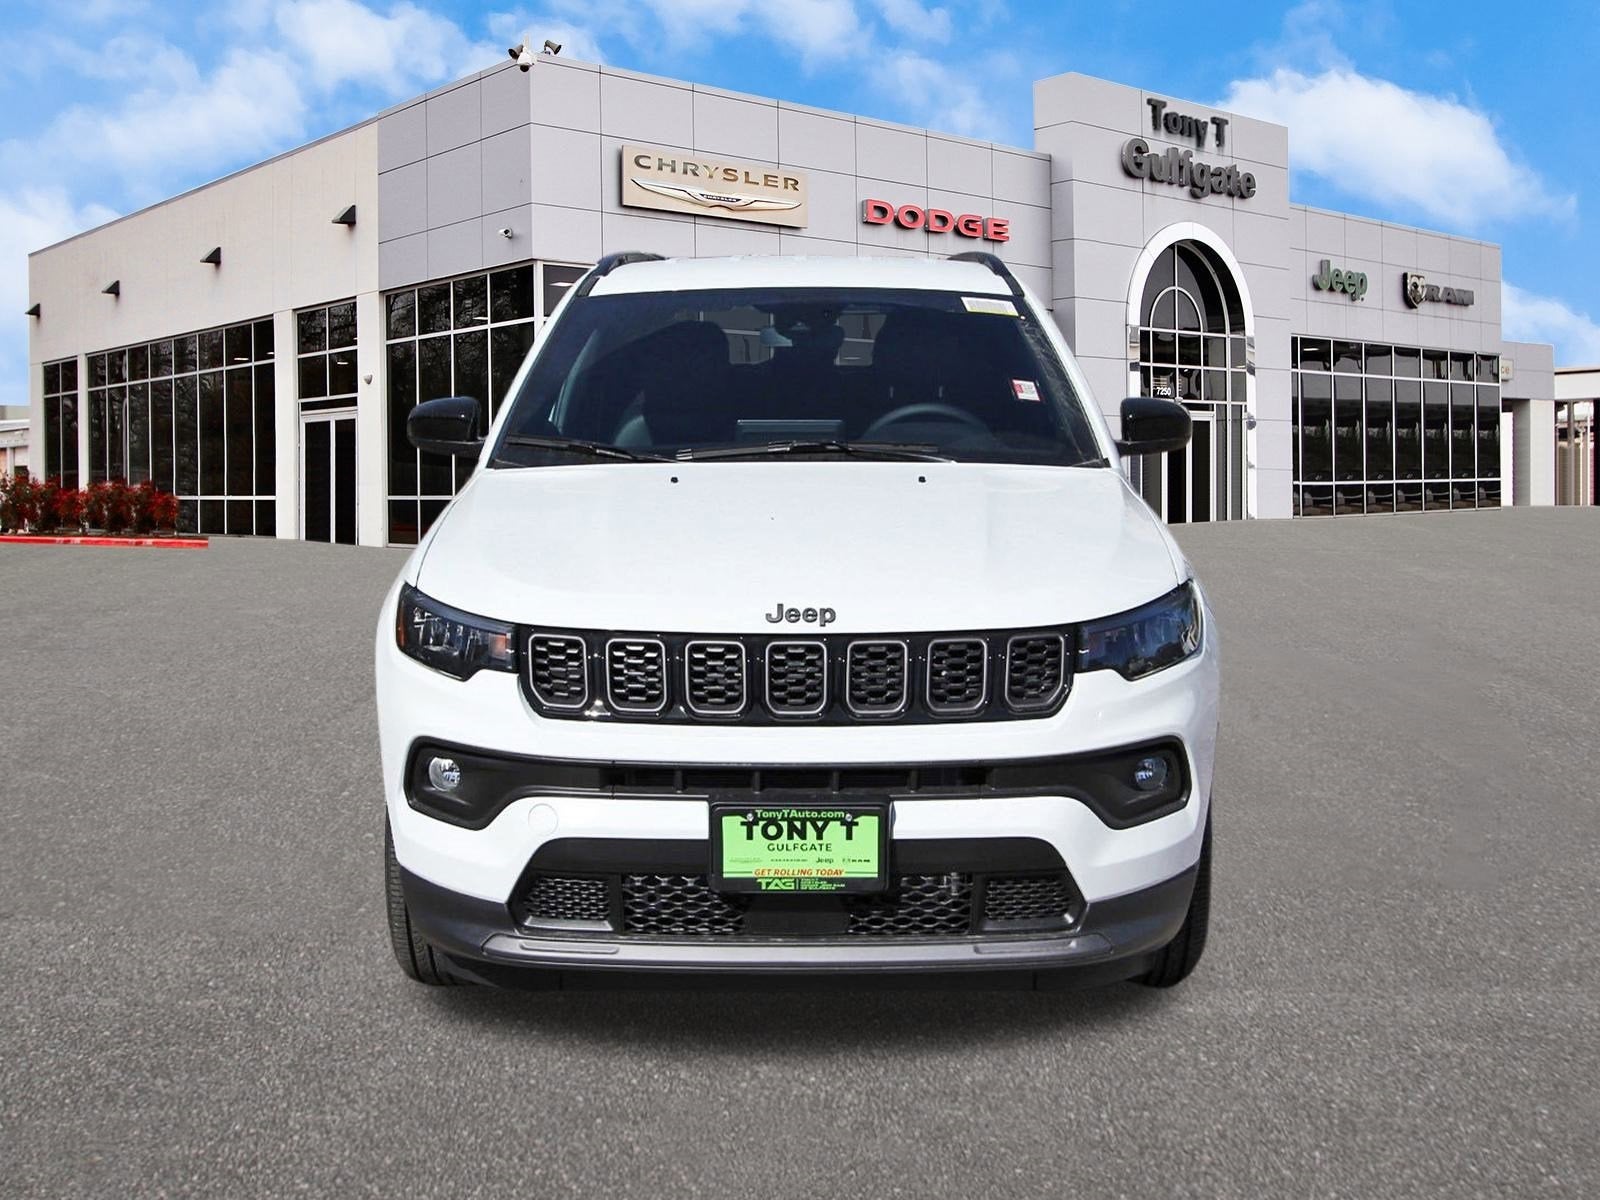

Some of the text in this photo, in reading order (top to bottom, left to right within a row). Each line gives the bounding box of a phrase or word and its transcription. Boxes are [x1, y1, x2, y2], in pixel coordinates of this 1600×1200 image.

[1146, 98, 1229, 147] Tony T
[633, 154, 800, 191] CHRYSLER
[1121, 138, 1256, 199] Gulfgate
[862, 198, 1010, 242] DODGE
[1312, 259, 1368, 302] Jeep
[1424, 283, 1474, 306] RAM
[765, 603, 837, 627] Jeep
[755, 809, 845, 819] TonyTAuto.com
[740, 820, 859, 841] TONY T
[767, 842, 833, 852] GULFGATE
[754, 868, 844, 876] GET ROLLING TODAY
[757, 878, 795, 890] TAG
